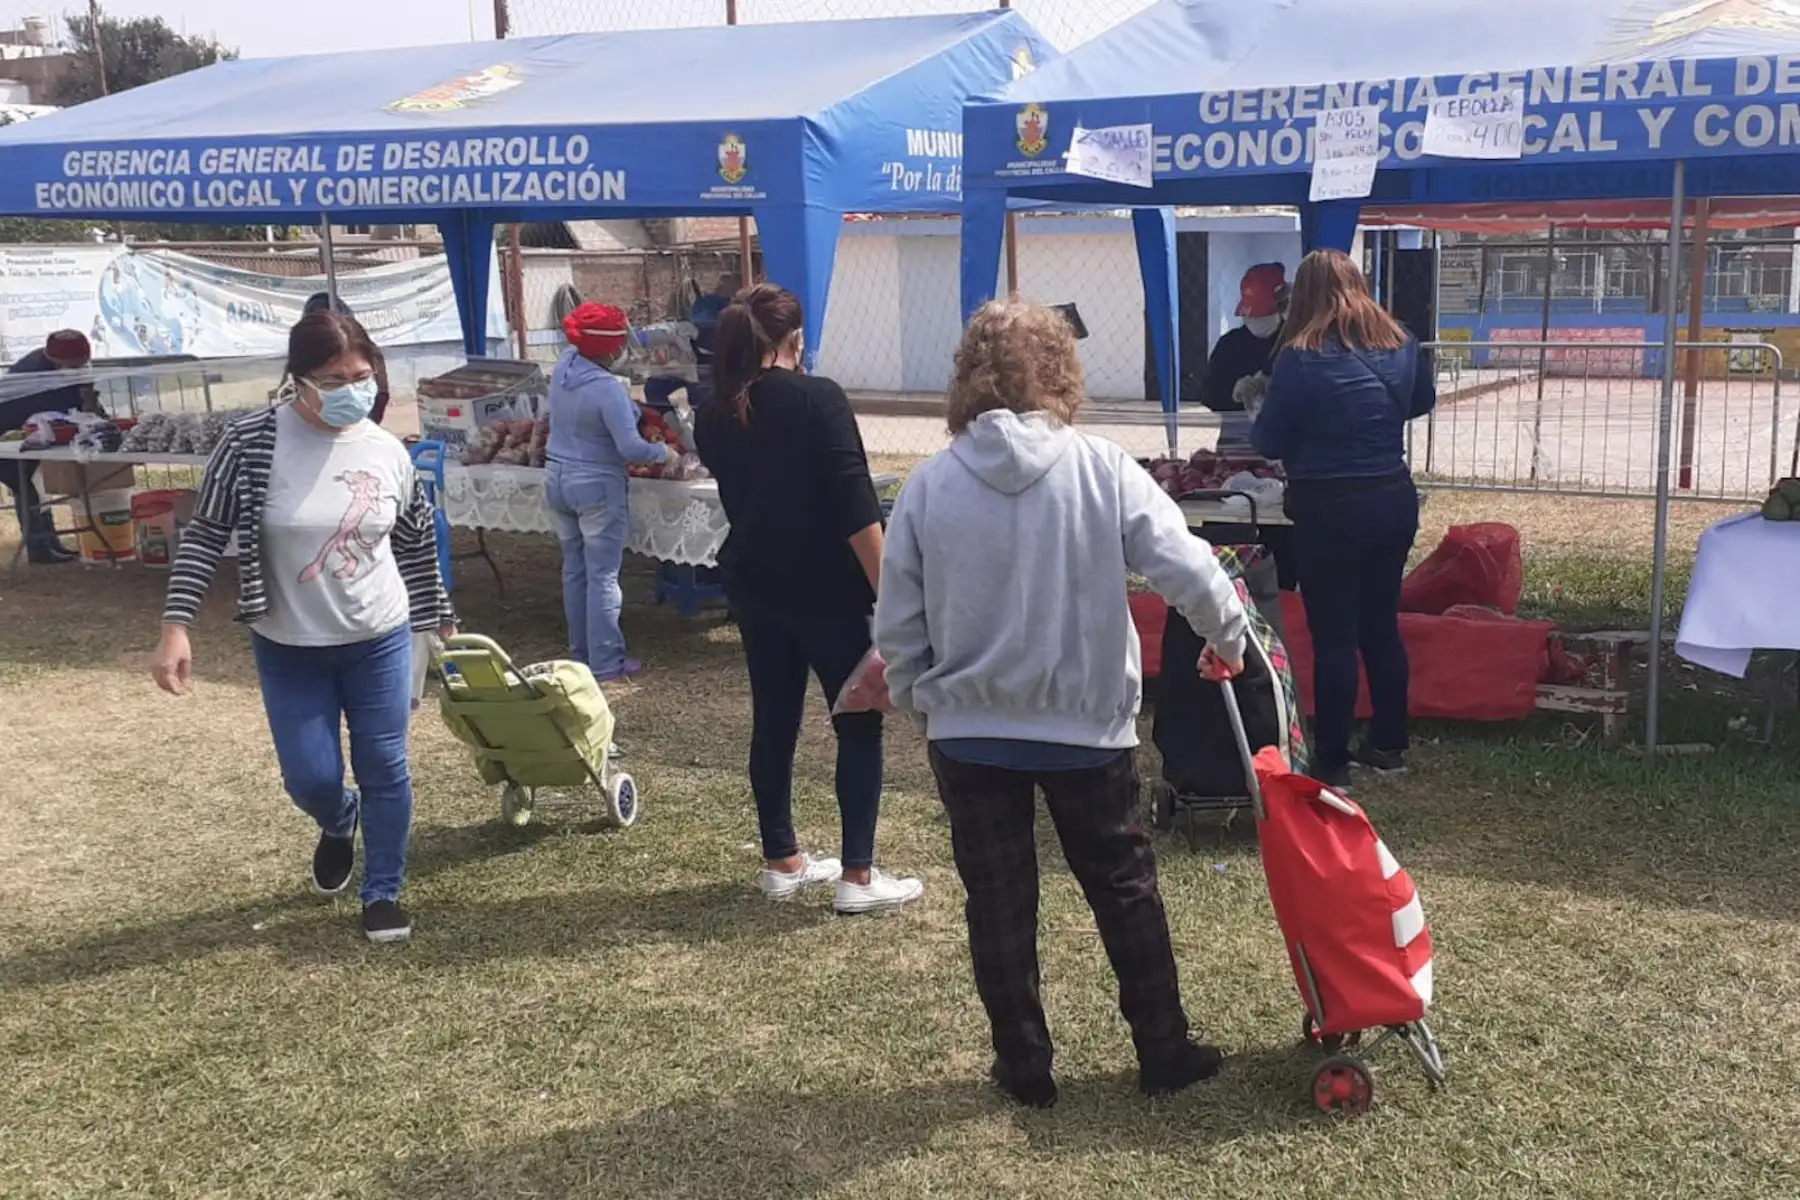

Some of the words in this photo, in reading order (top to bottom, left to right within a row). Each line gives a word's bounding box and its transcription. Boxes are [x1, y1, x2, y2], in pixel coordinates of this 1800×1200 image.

[1200, 77, 1438, 124] GERENCIA
[1734, 55, 1800, 96] DE
[1636, 107, 1676, 148] Y
[63, 149, 191, 177] GERENCIA
[200, 145, 326, 175] GENERAL
[336, 144, 375, 172] DE
[383, 134, 589, 170] DESARROLLO
[35, 174, 184, 209] ECONÓMICO
[193, 179, 281, 208] LOCAL
[288, 178, 307, 206] Y
[315, 164, 626, 206] COMERCIALIZACIÓN
[926, 162, 942, 191] la
[945, 164, 963, 198] di
